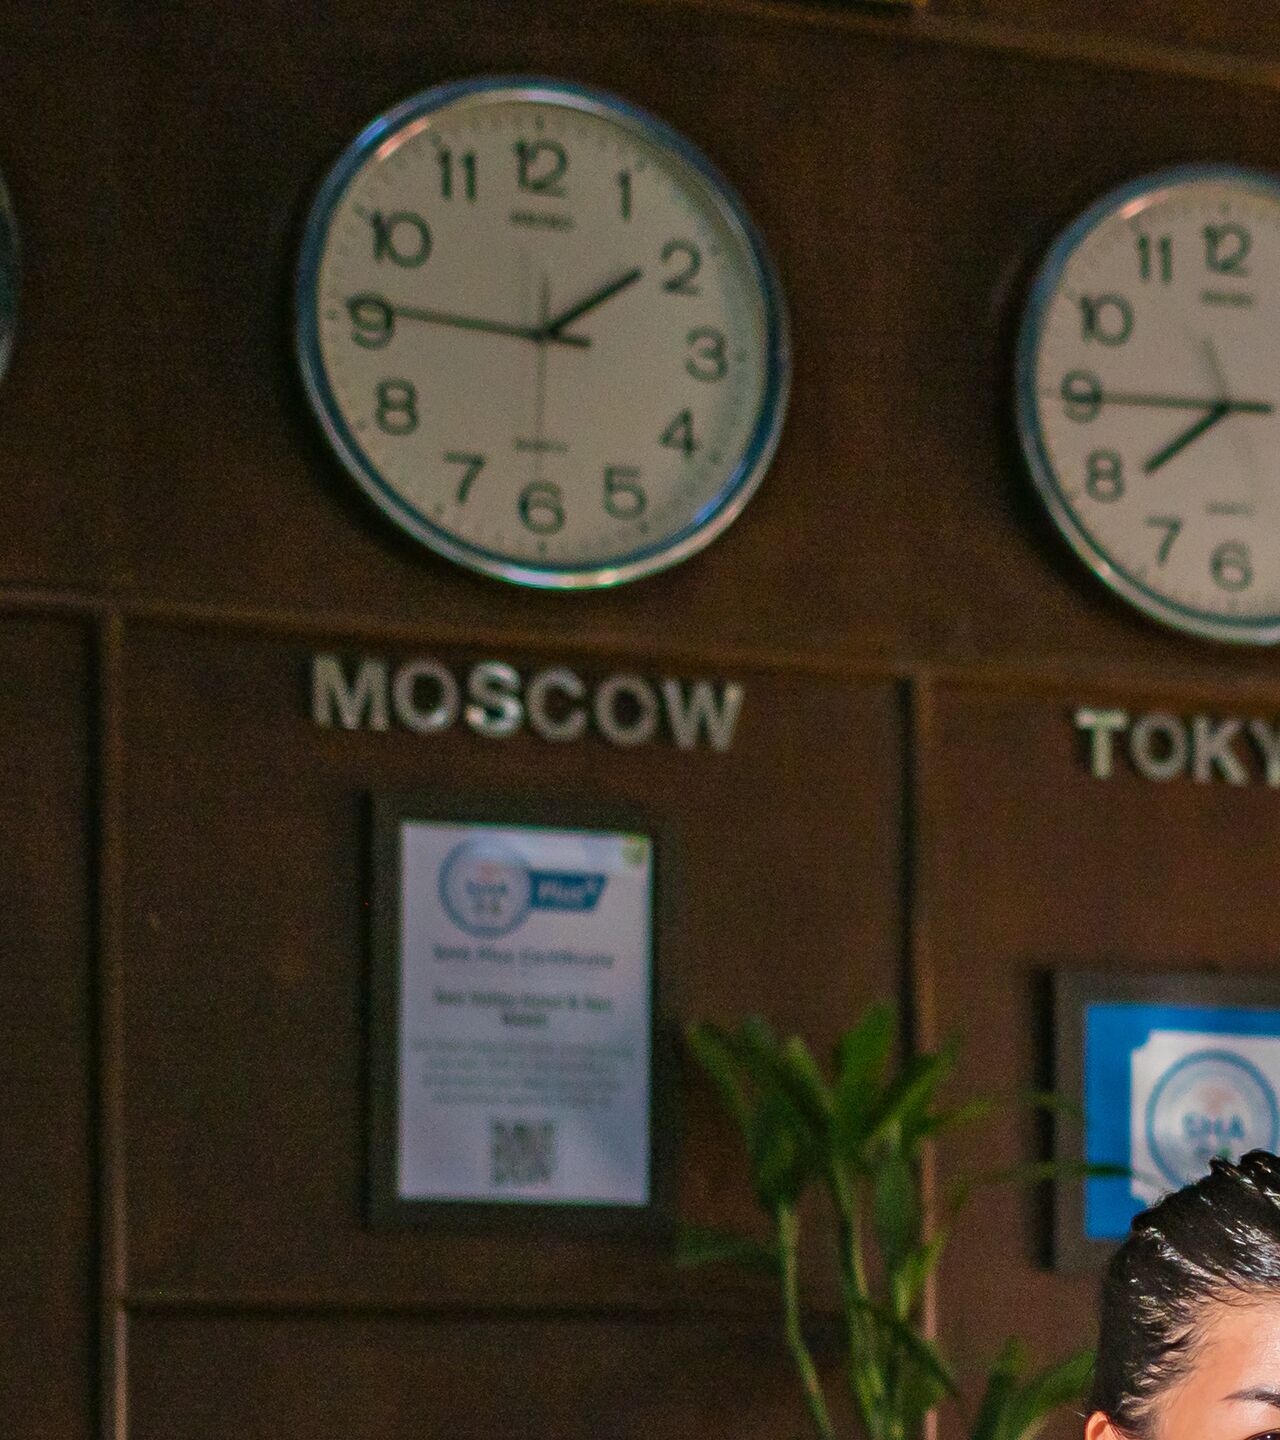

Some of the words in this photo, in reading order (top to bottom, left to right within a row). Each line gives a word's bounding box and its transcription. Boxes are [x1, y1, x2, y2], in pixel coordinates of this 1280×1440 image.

[438, 149, 478, 204] 11
[513, 138, 569, 198] 12
[616, 170, 632, 221] 1
[370, 210, 432, 268] 10
[1138, 234, 1172, 285] 11
[1203, 223, 1252, 276] 12
[660, 238, 700, 296] 2
[347, 290, 393, 349] 9
[1080, 294, 1135, 347] 10
[685, 326, 728, 382] 3
[374, 378, 419, 436] 8
[1061, 370, 1101, 423] 9
[659, 408, 699, 457] 4
[443, 451, 486, 505] 7
[603, 465, 648, 521] 5
[1085, 448, 1125, 502] 8
[518, 481, 565, 535] 6
[1146, 517, 1182, 566] 7
[1210, 540, 1252, 592] 6
[312, 654, 745, 752] MOSCOW
